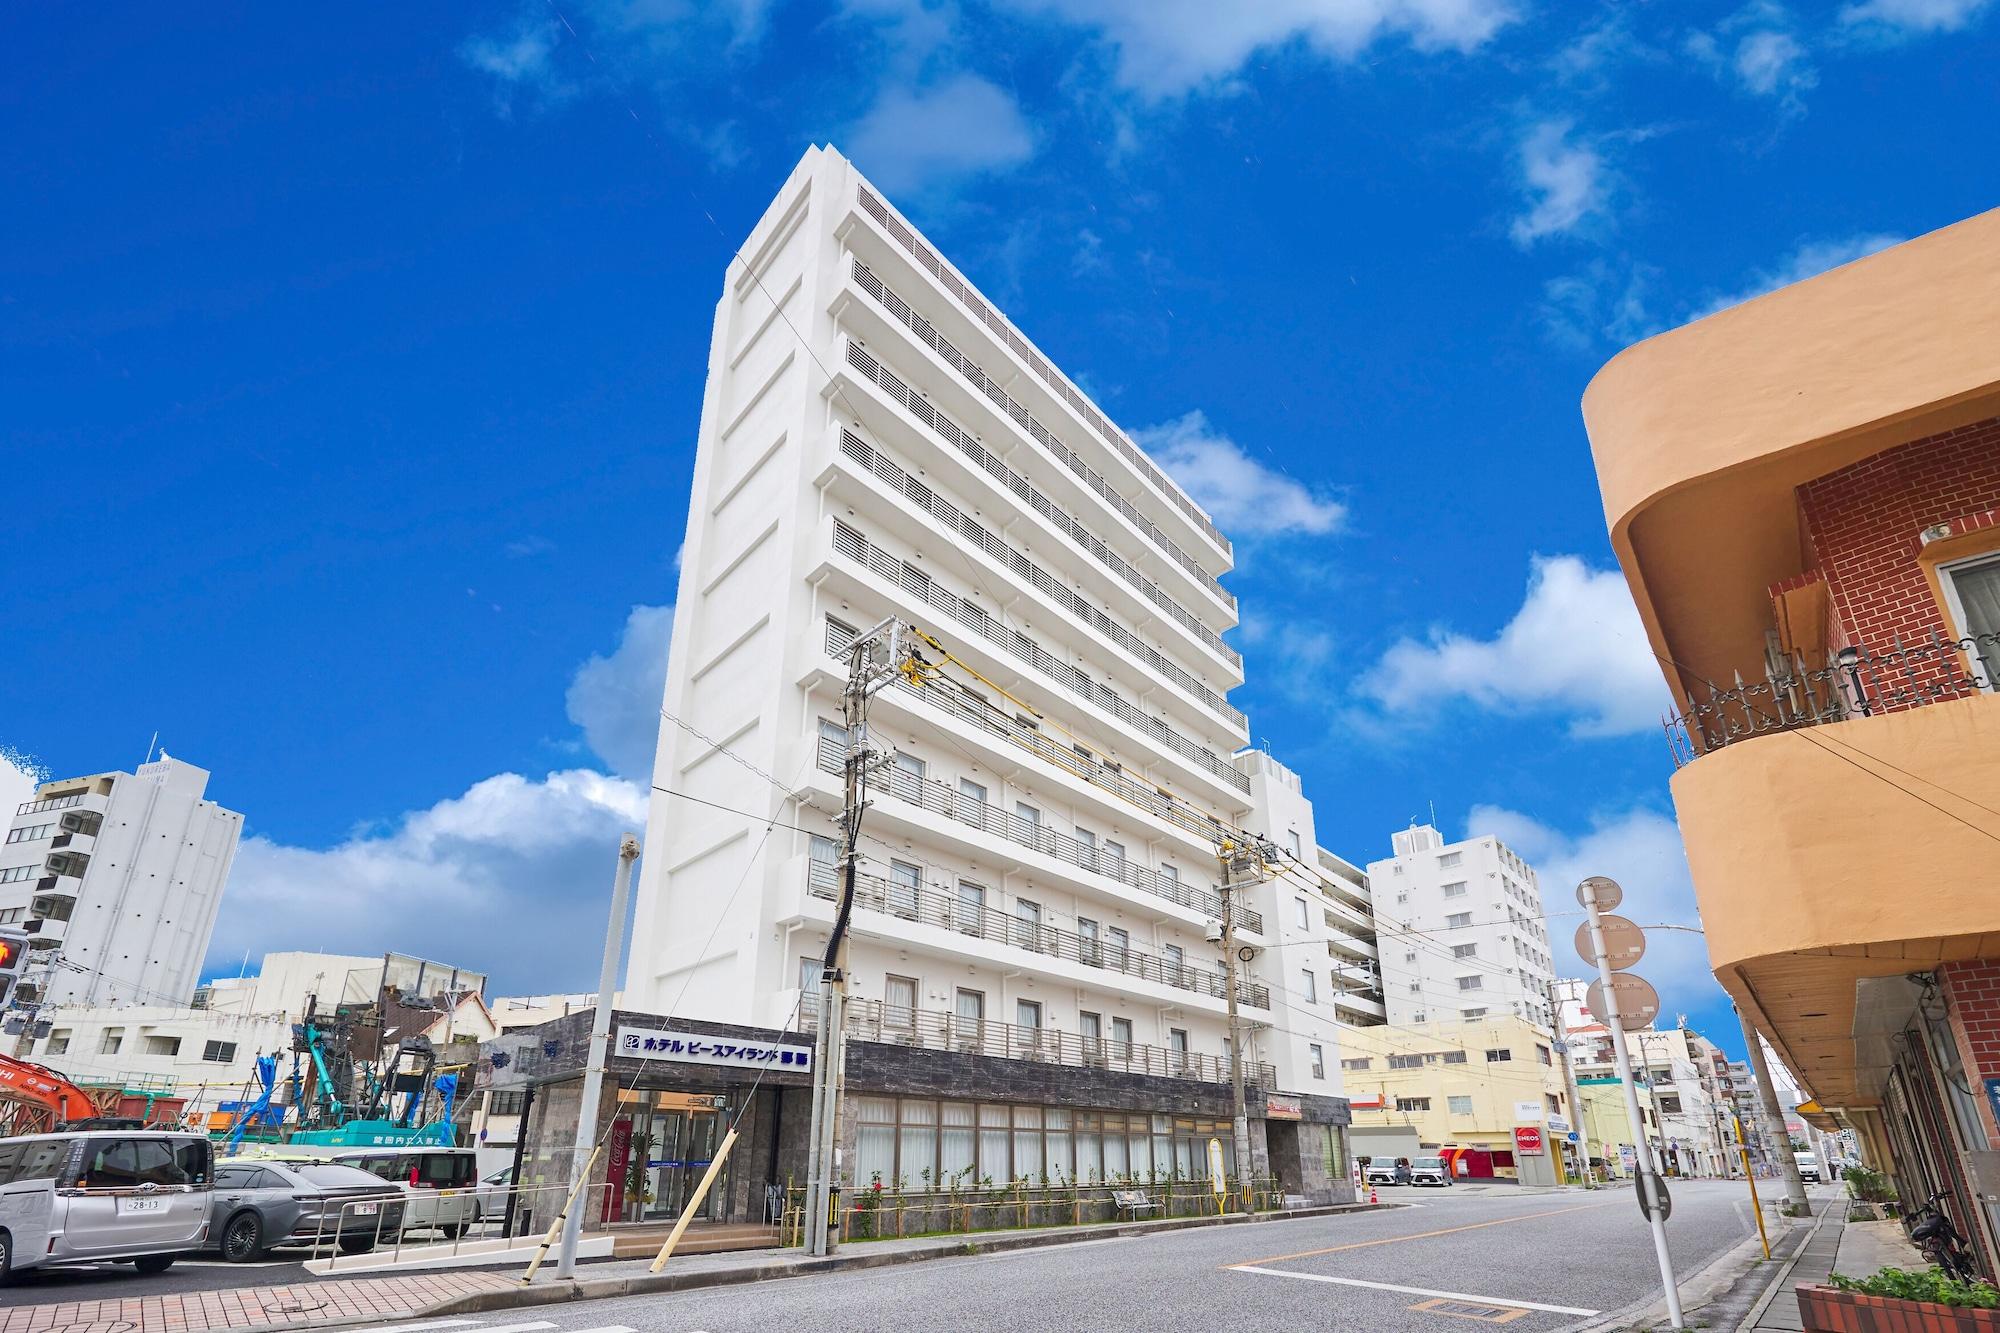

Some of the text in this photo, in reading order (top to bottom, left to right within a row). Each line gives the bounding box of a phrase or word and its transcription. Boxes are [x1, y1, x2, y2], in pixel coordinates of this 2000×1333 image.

[643, 1037, 685, 1055] ホテル
[0, 1068, 15, 1081] HI
